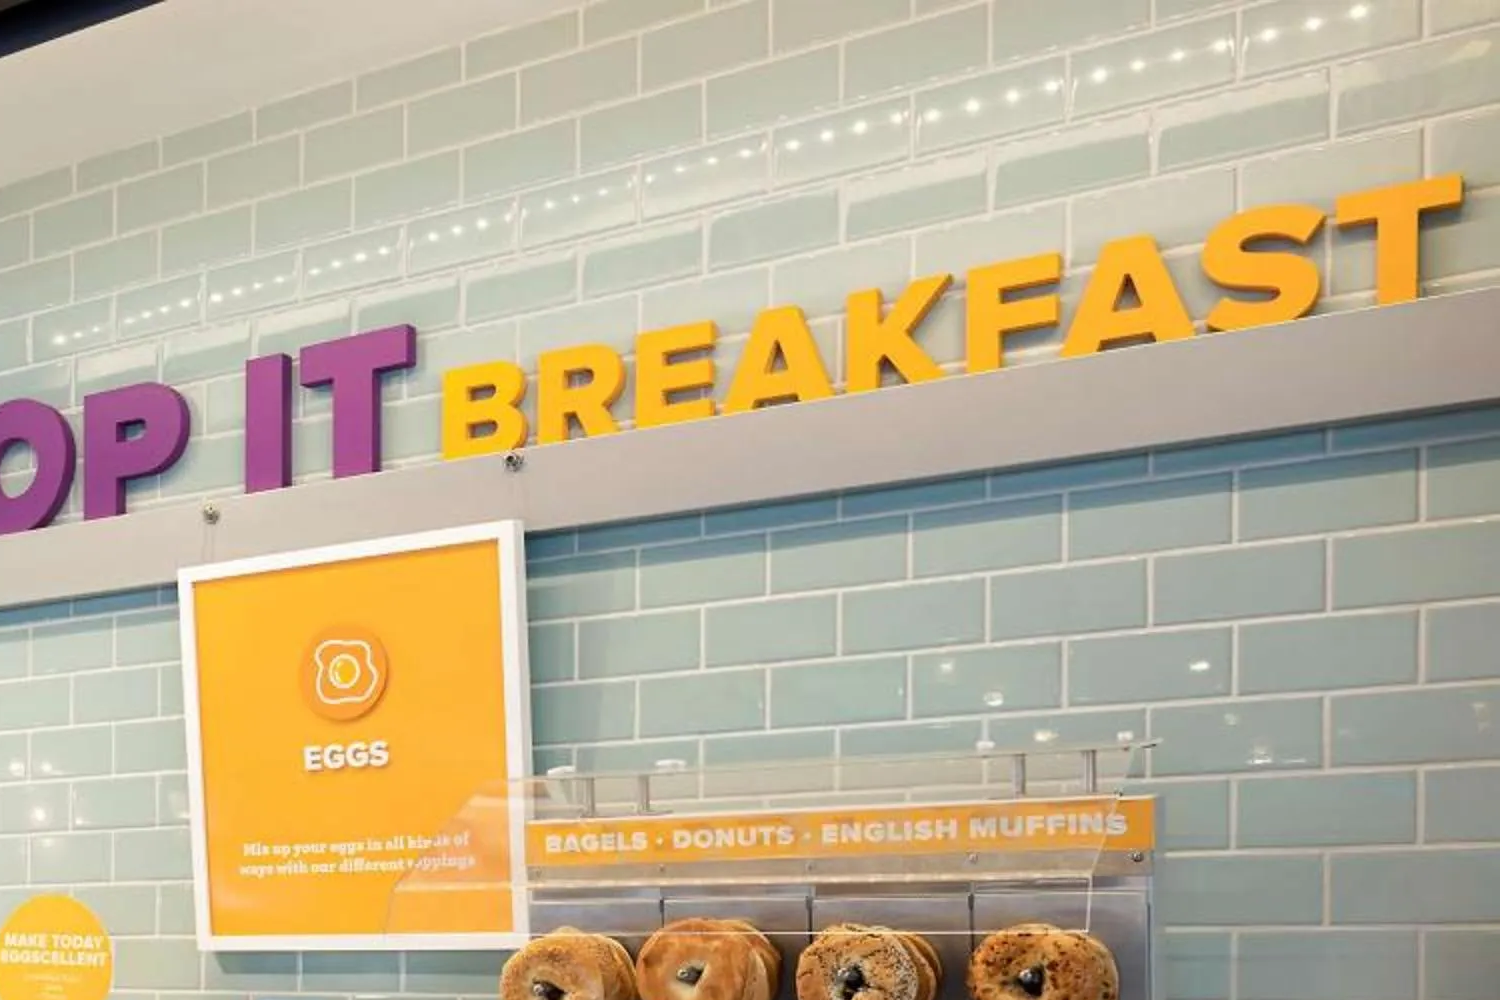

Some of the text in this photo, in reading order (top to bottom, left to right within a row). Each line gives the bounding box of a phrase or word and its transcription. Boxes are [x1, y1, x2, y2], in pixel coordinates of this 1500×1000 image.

[244, 323, 417, 494] IT
[440, 173, 1465, 460] BREAKFAST
[303, 740, 389, 770] EGGS
[545, 813, 1128, 853] BAGELS DONUTS ENGLISH MUFFINS
[291, 843, 328, 858] your
[329, 841, 364, 857] eggs
[366, 838, 382, 852] in
[385, 836, 404, 850] all
[239, 853, 476, 879] ways with our different tppings
[4, 932, 104, 949] MAKE TODAY
[0, 948, 106, 967] EGGSCELLENT
